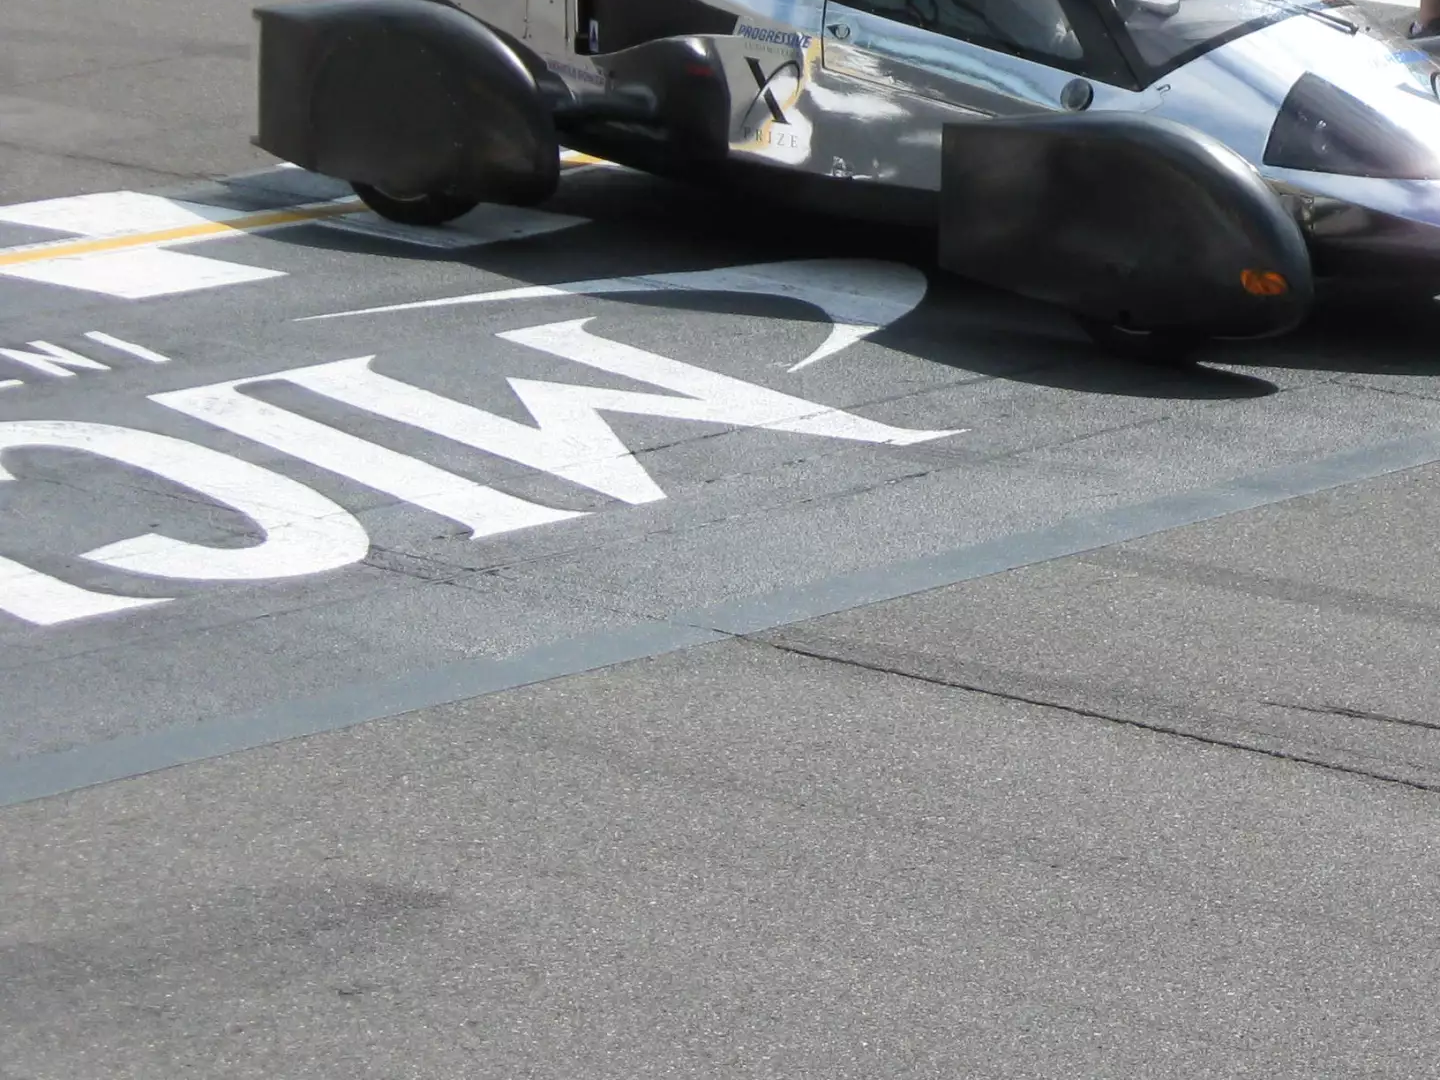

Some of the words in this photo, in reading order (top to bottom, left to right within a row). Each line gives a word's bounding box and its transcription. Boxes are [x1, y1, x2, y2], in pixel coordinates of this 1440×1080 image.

[738, 23, 812, 49] PROGRESSIVE
[743, 126, 799, 149] PRIZE
[0, 330, 172, 388] IN
